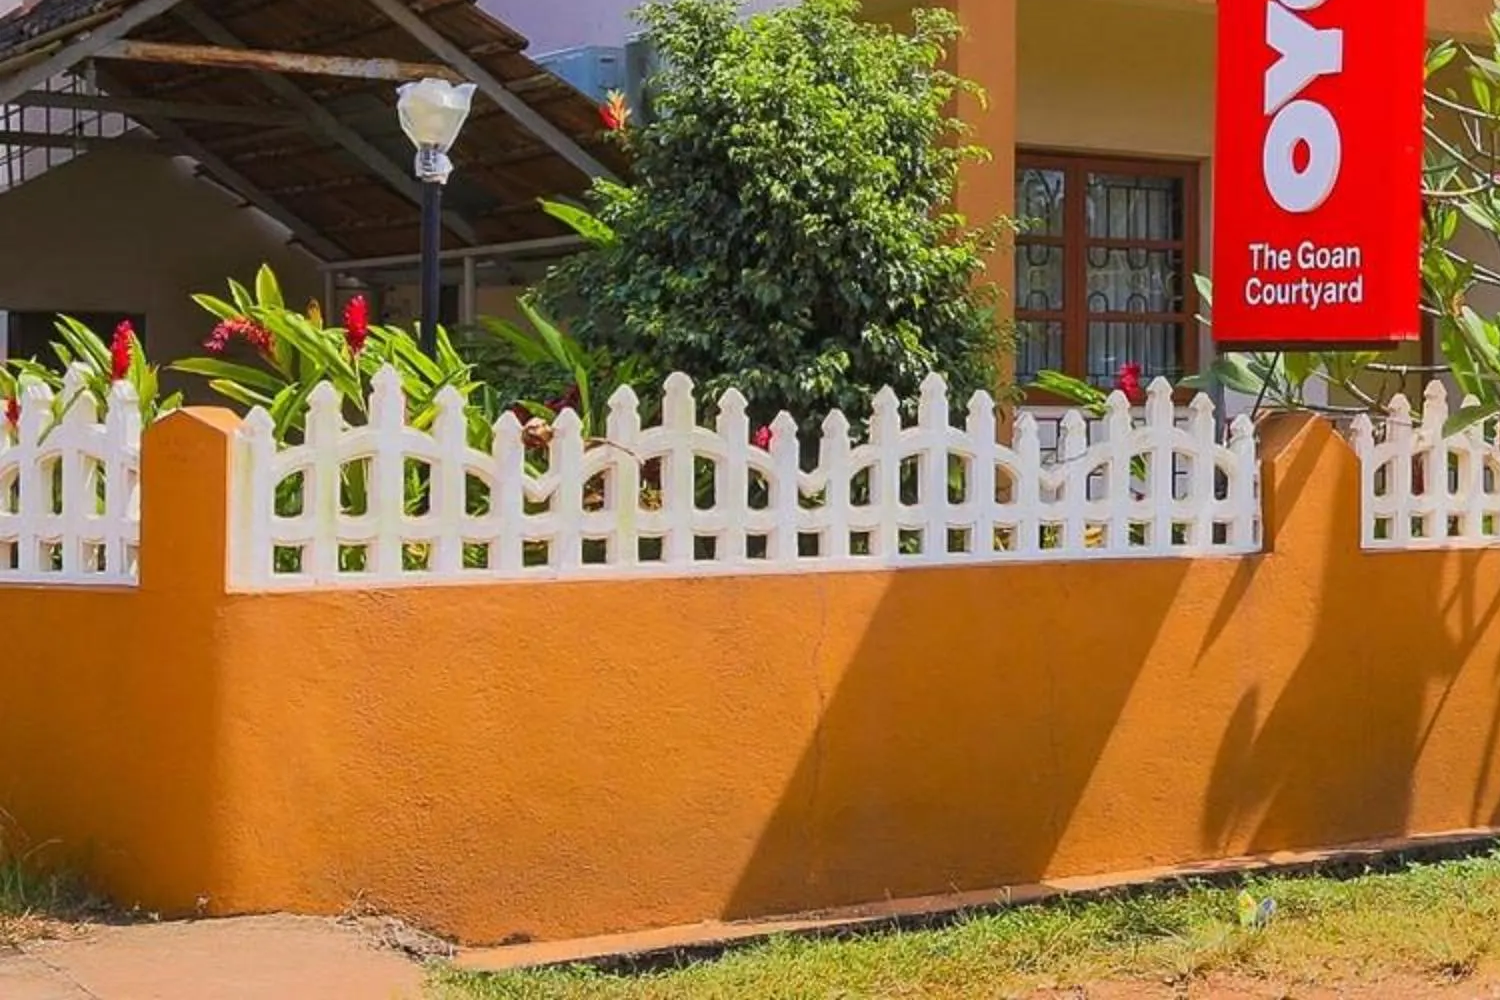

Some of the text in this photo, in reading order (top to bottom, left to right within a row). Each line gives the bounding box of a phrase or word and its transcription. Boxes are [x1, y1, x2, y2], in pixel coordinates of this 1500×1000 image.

[1249, 241, 1361, 270] The Goan
[1245, 274, 1363, 310] Courtyard
